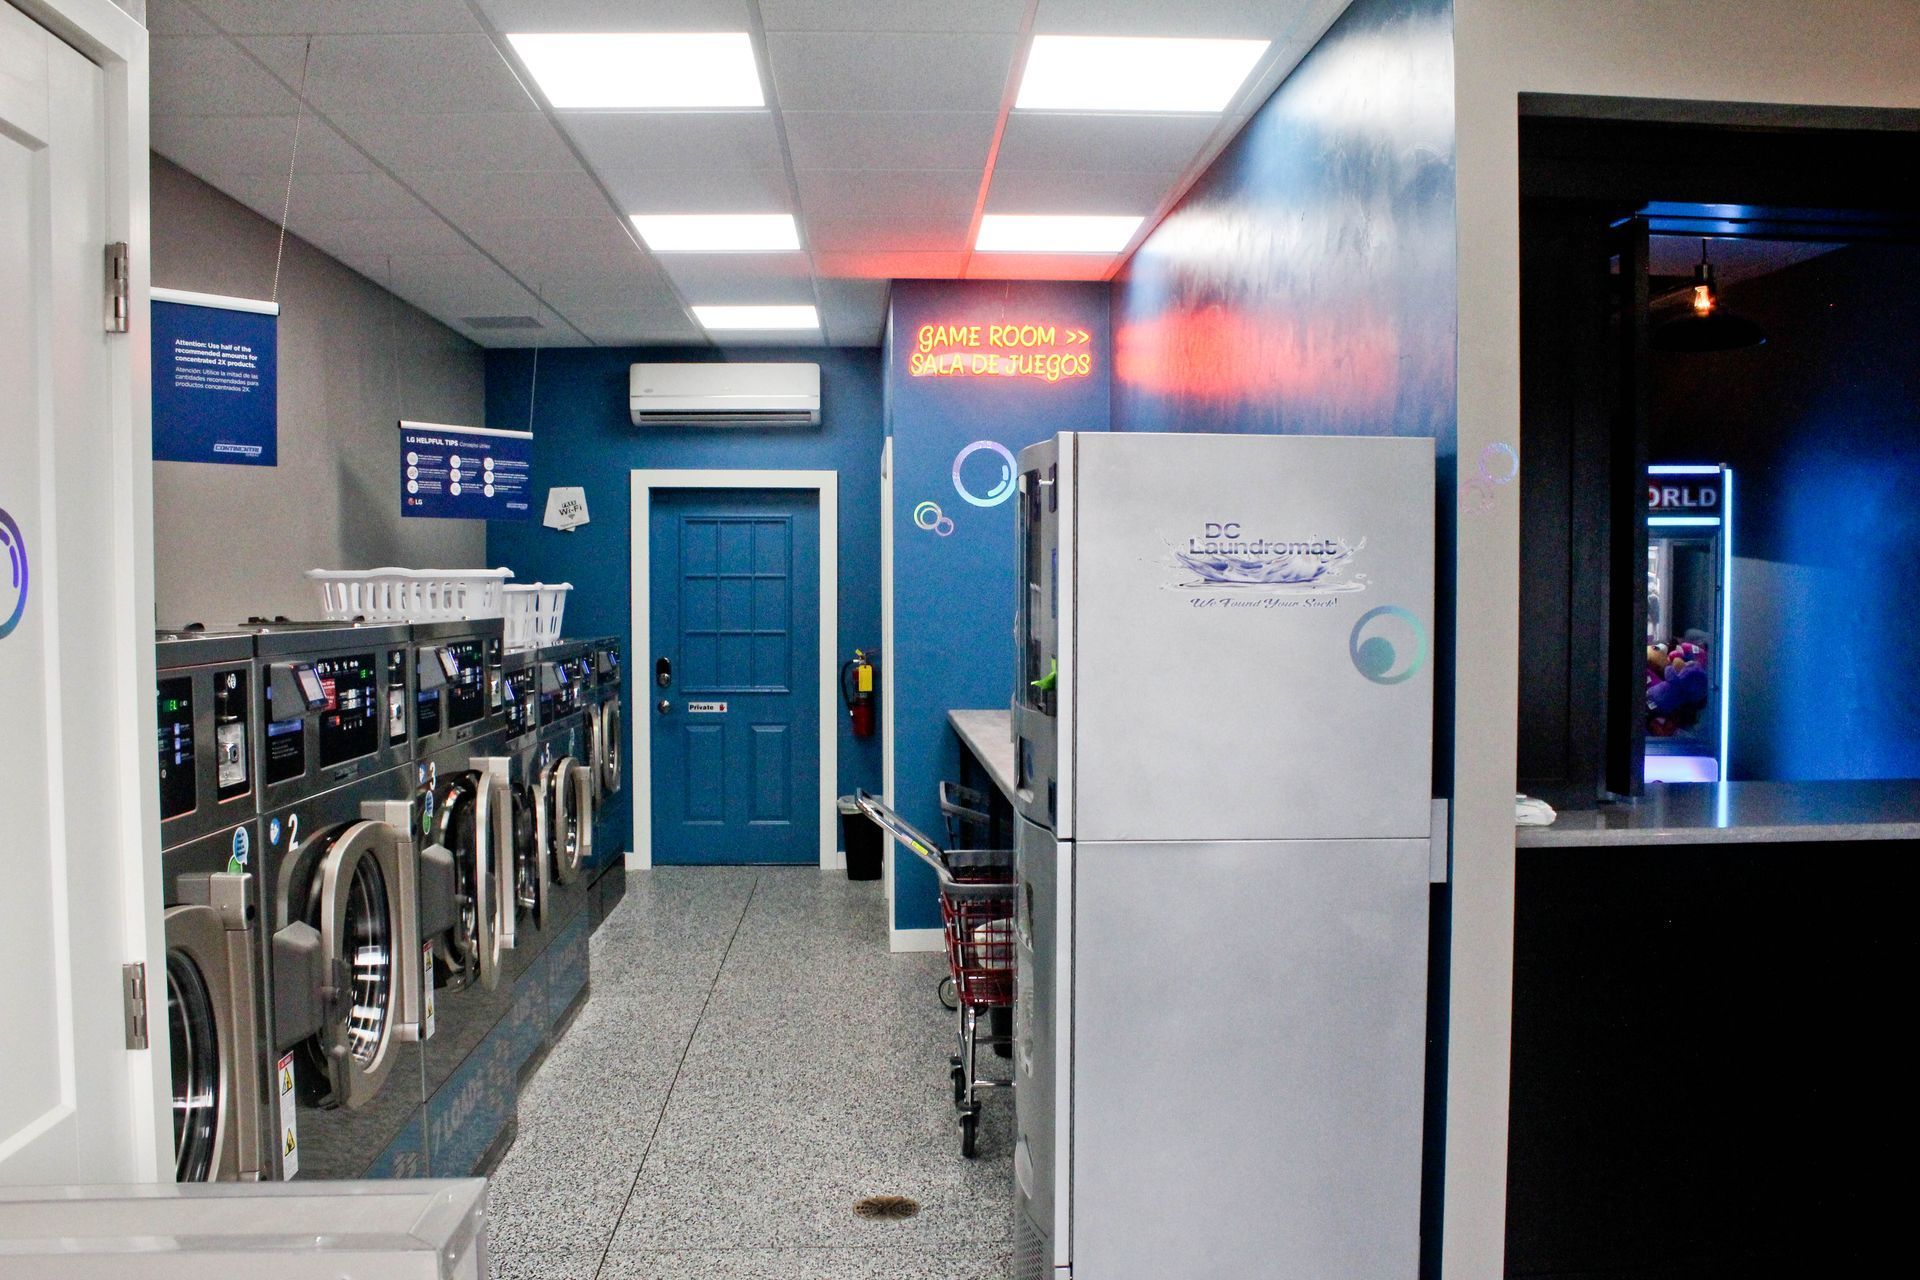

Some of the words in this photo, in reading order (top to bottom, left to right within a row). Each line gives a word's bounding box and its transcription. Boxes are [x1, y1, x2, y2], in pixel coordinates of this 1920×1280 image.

[175, 339, 207, 348] Attention:
[918, 325, 981, 352] GAME
[990, 325, 1056, 347] ROOM
[175, 348, 220, 357] recommended
[222, 352, 248, 360] amounts
[175, 356, 216, 365] concentrated
[227, 361, 256, 369] products.
[911, 353, 965, 376] SALA
[972, 354, 1000, 375] DE
[1005, 353, 1091, 381] JUEGOS
[416, 437, 444, 446] HELPFUL
[1205, 522, 1240, 539] DC
[1190, 539, 1338, 555] Laundromat
[1190, 598, 1216, 608] We
[1219, 598, 1260, 608] Found
[1264, 598, 1299, 609] Your
[430, 762, 436, 791] 3
[288, 814, 299, 852] 2
